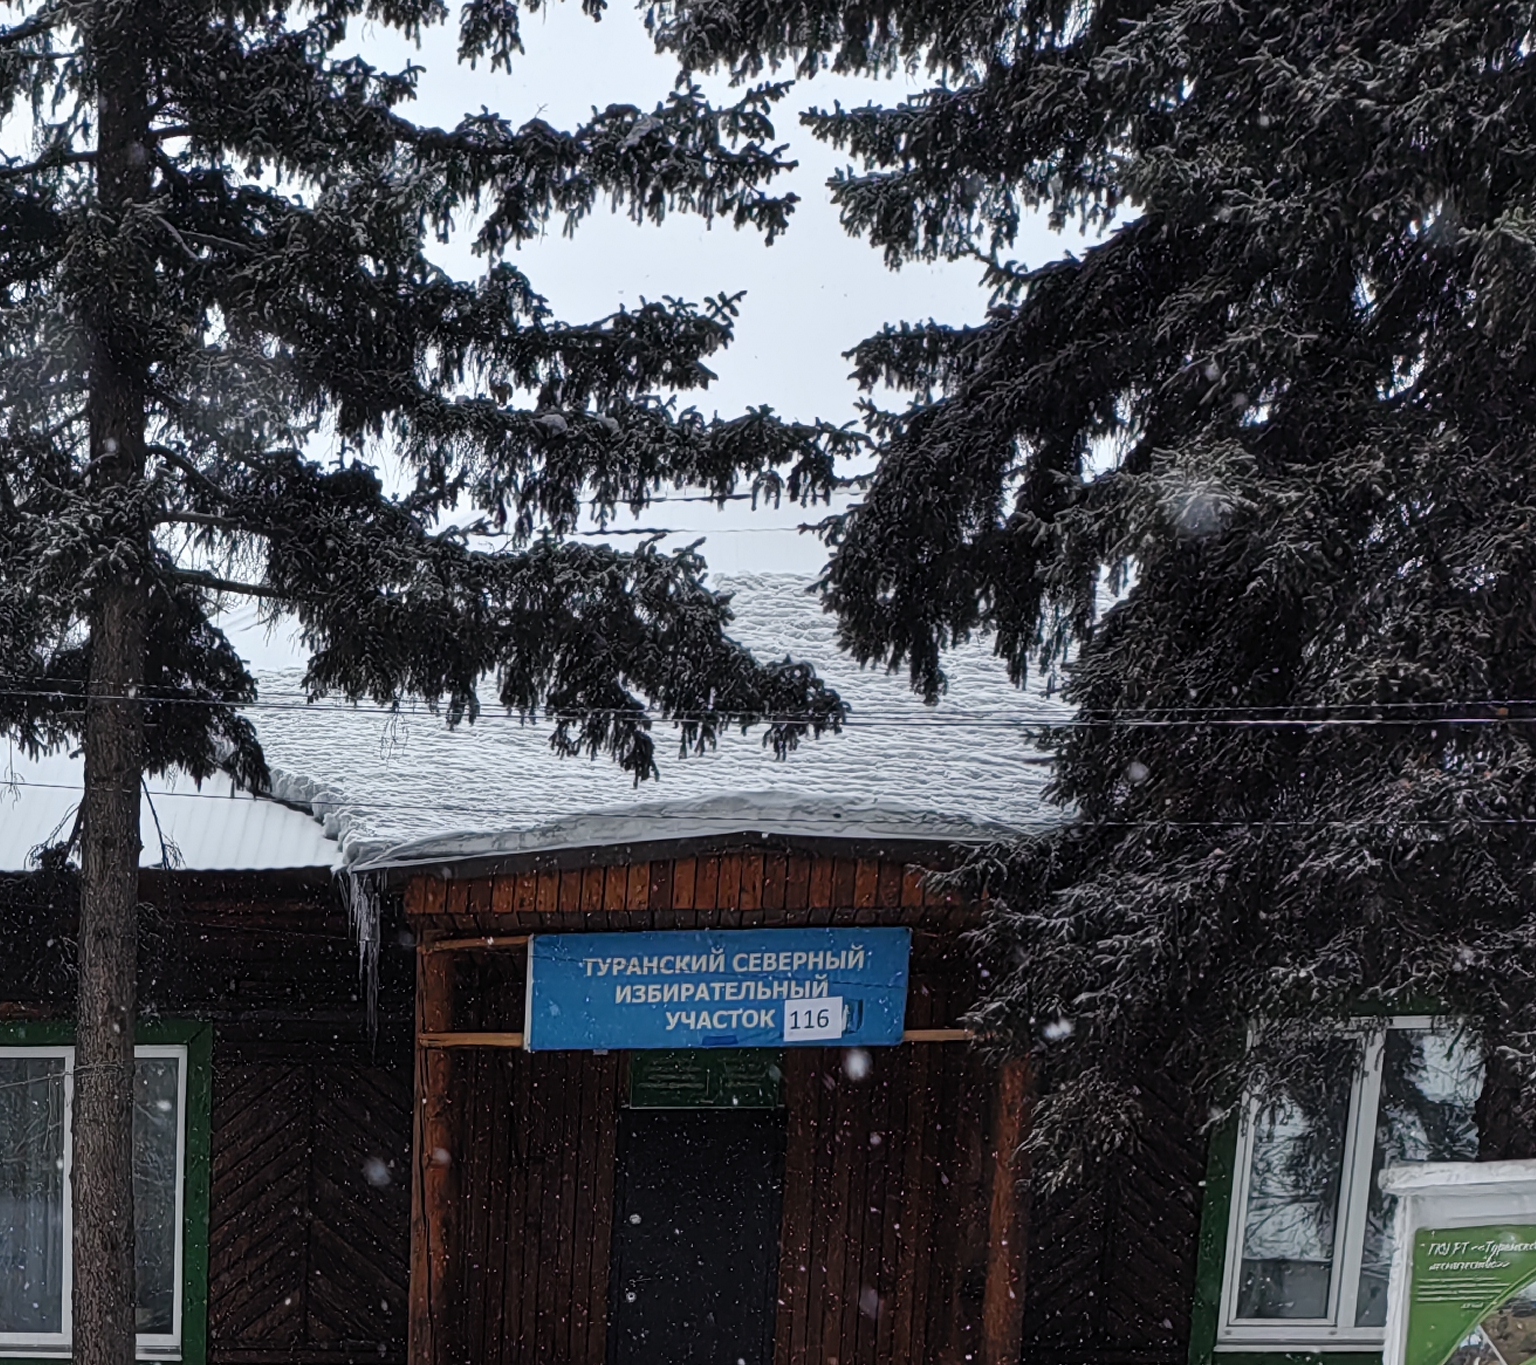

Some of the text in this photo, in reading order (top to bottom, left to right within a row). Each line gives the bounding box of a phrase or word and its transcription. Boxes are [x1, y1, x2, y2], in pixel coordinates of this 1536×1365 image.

[583, 944, 865, 977] ТУРАНСКИЙ СЕВЕРНЫЙ
[615, 974, 829, 1004] ИЗБИРАТЕЛЬНЫЙ
[665, 1008, 830, 1031] УЧАСТОК 116
